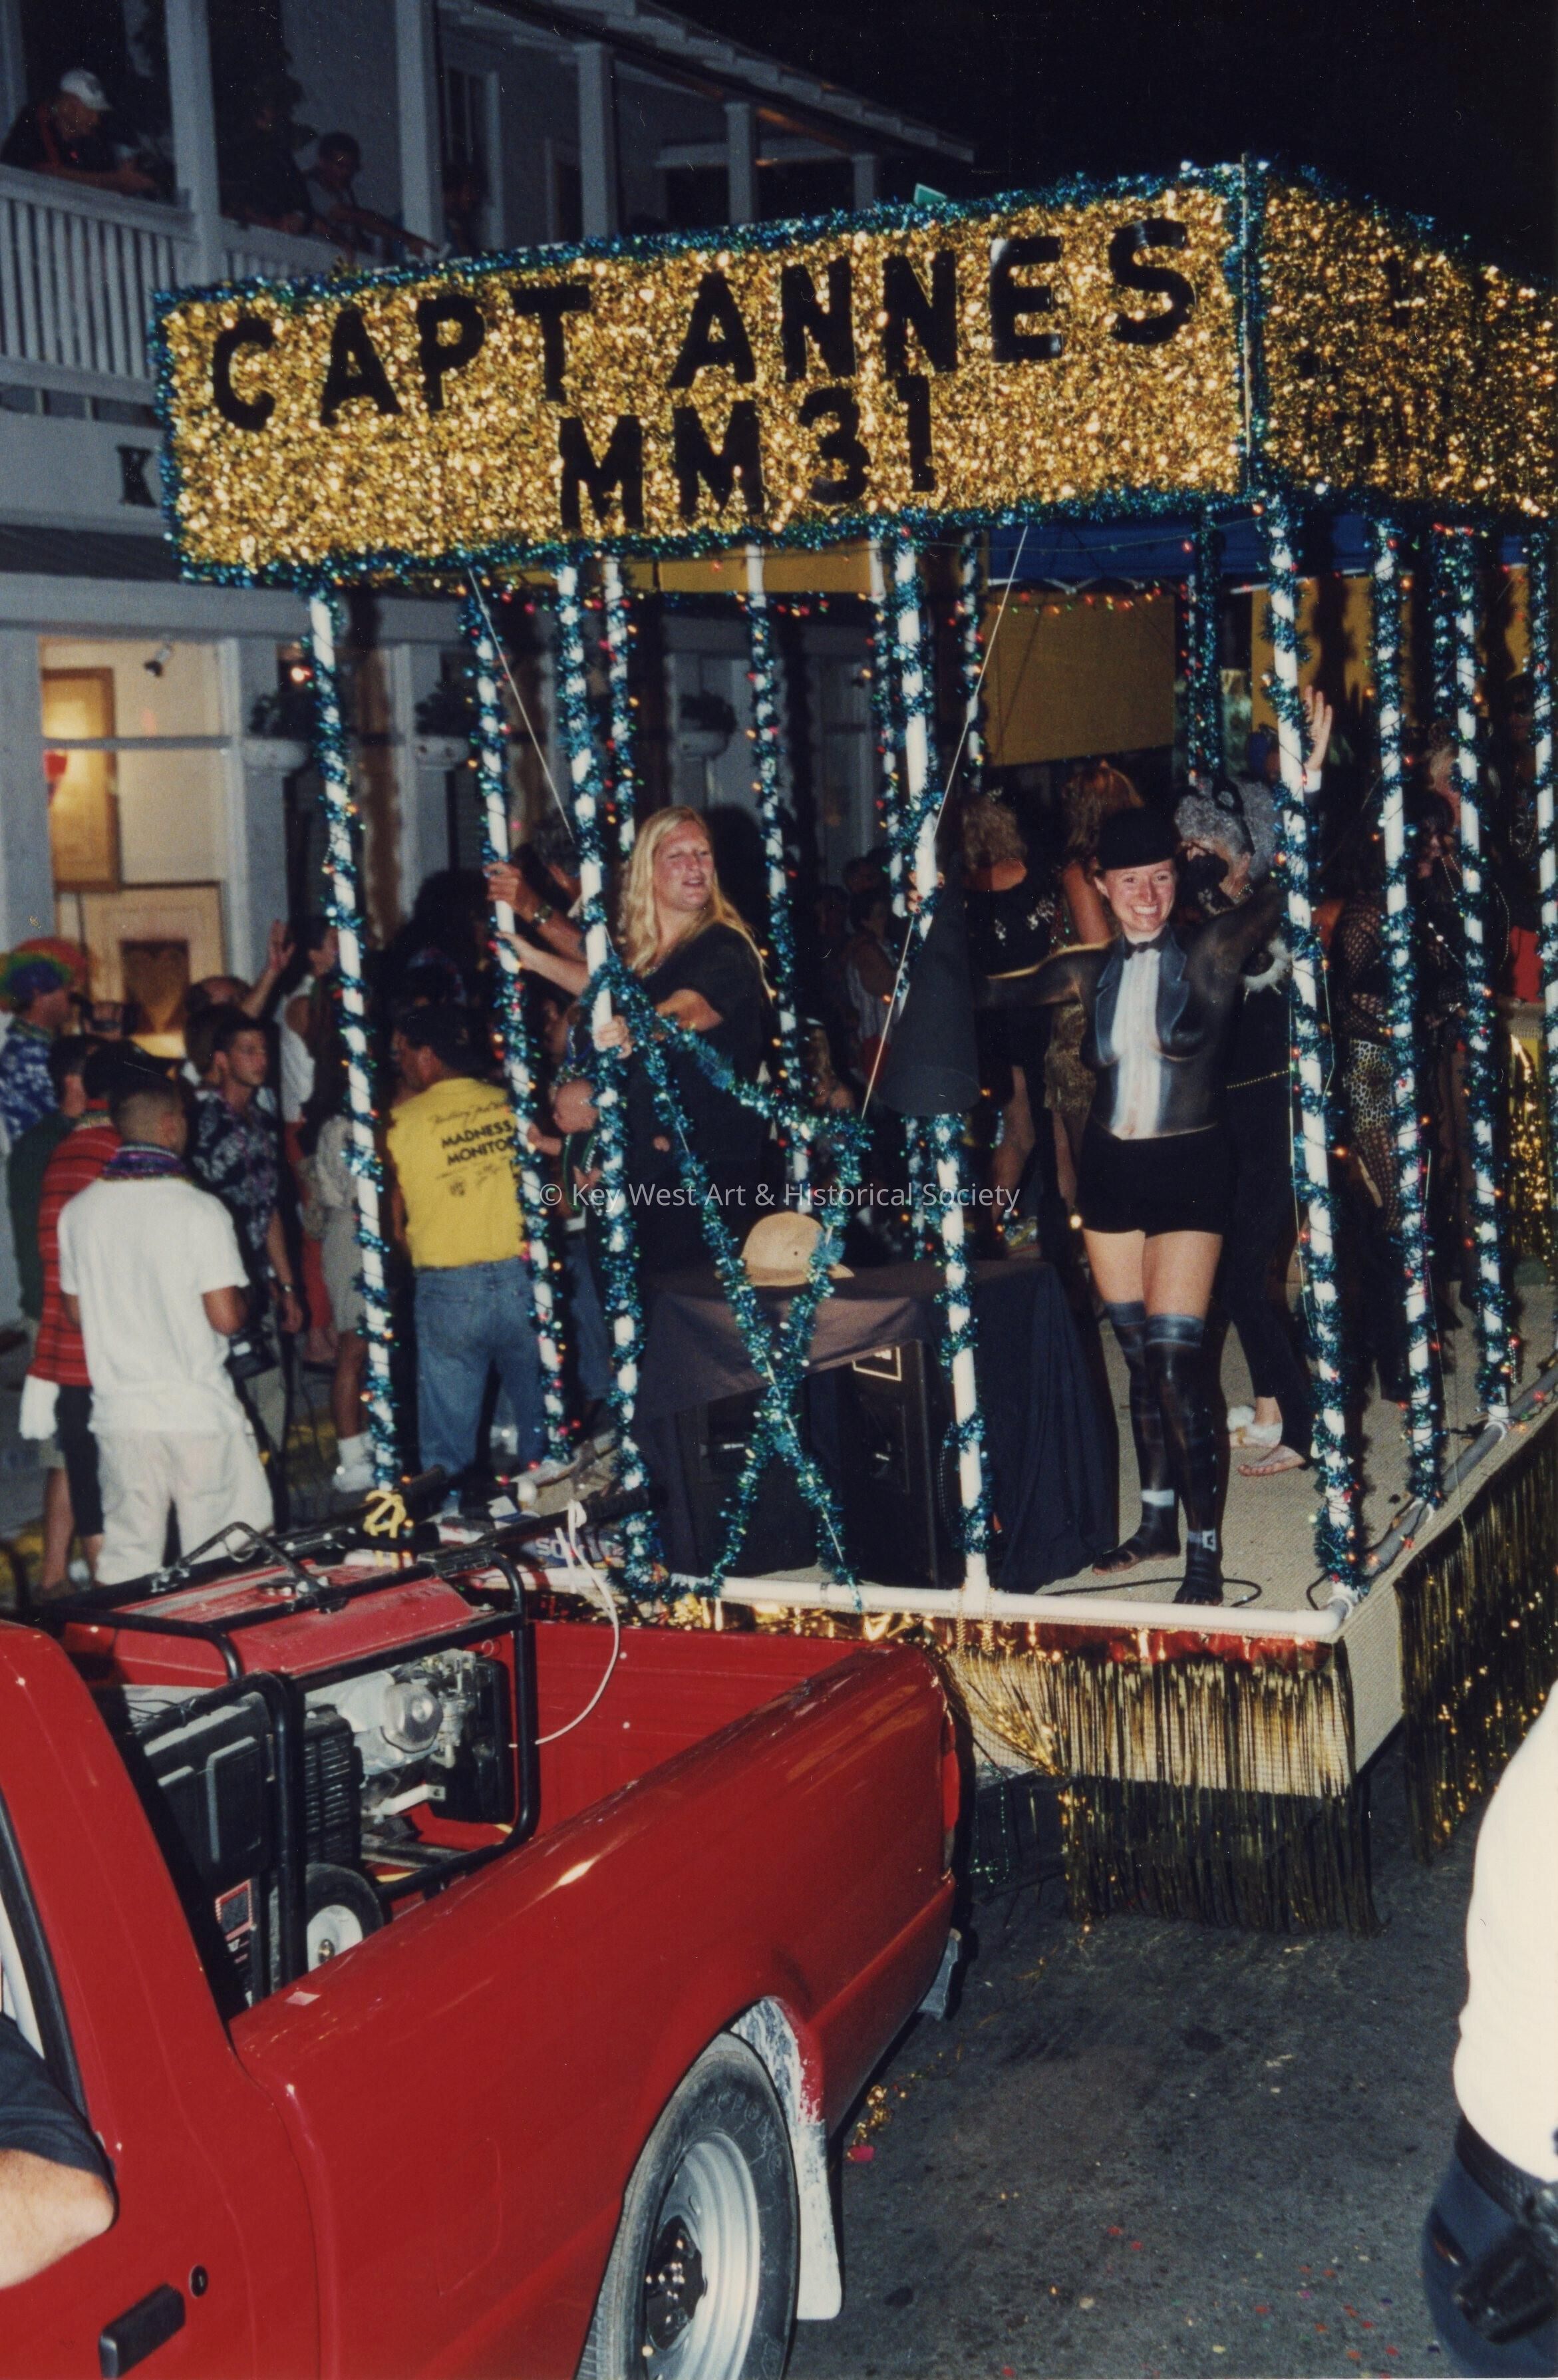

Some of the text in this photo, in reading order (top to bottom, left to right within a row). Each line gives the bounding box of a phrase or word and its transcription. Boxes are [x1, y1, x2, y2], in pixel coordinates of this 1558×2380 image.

[212, 217, 1196, 430] CAPT ANNES
[442, 1120, 512, 1149] MADNESS
